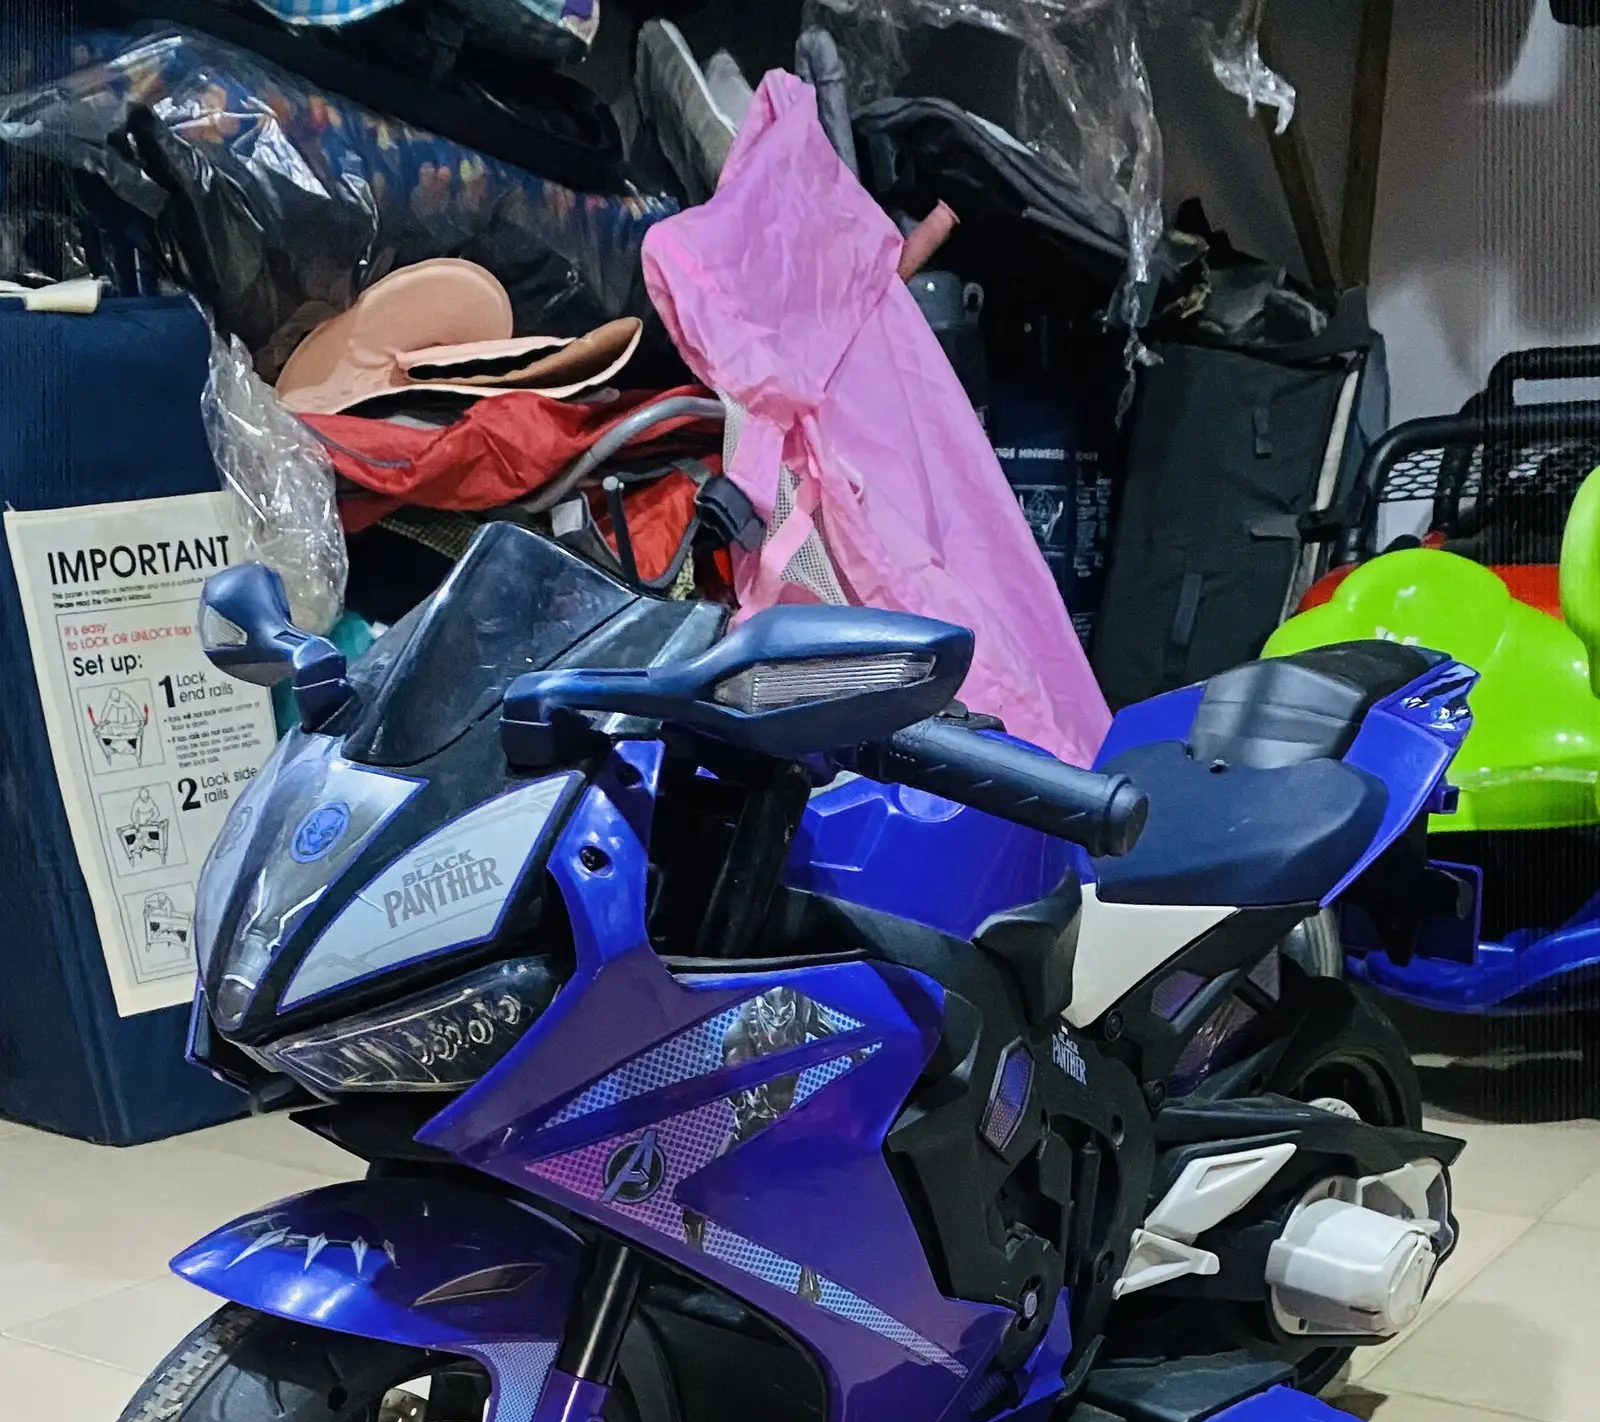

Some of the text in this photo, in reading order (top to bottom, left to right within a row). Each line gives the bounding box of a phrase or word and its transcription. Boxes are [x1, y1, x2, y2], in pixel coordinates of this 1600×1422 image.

[47, 535, 229, 585] IMPORTANT
[80, 636, 109, 650] LOCK
[112, 633, 128, 645] OR
[131, 627, 173, 642] UNLOCK
[73, 653, 143, 677] Set up:
[158, 671, 207, 708] 1 Lock
[179, 681, 234, 702] end rails
[177, 766, 258, 811] 2 Lock side
[204, 788, 229, 803] rails
[402, 849, 477, 887] BLACK
[383, 857, 504, 929] PANTHER
[1052, 1033, 1087, 1085] PANTHER
